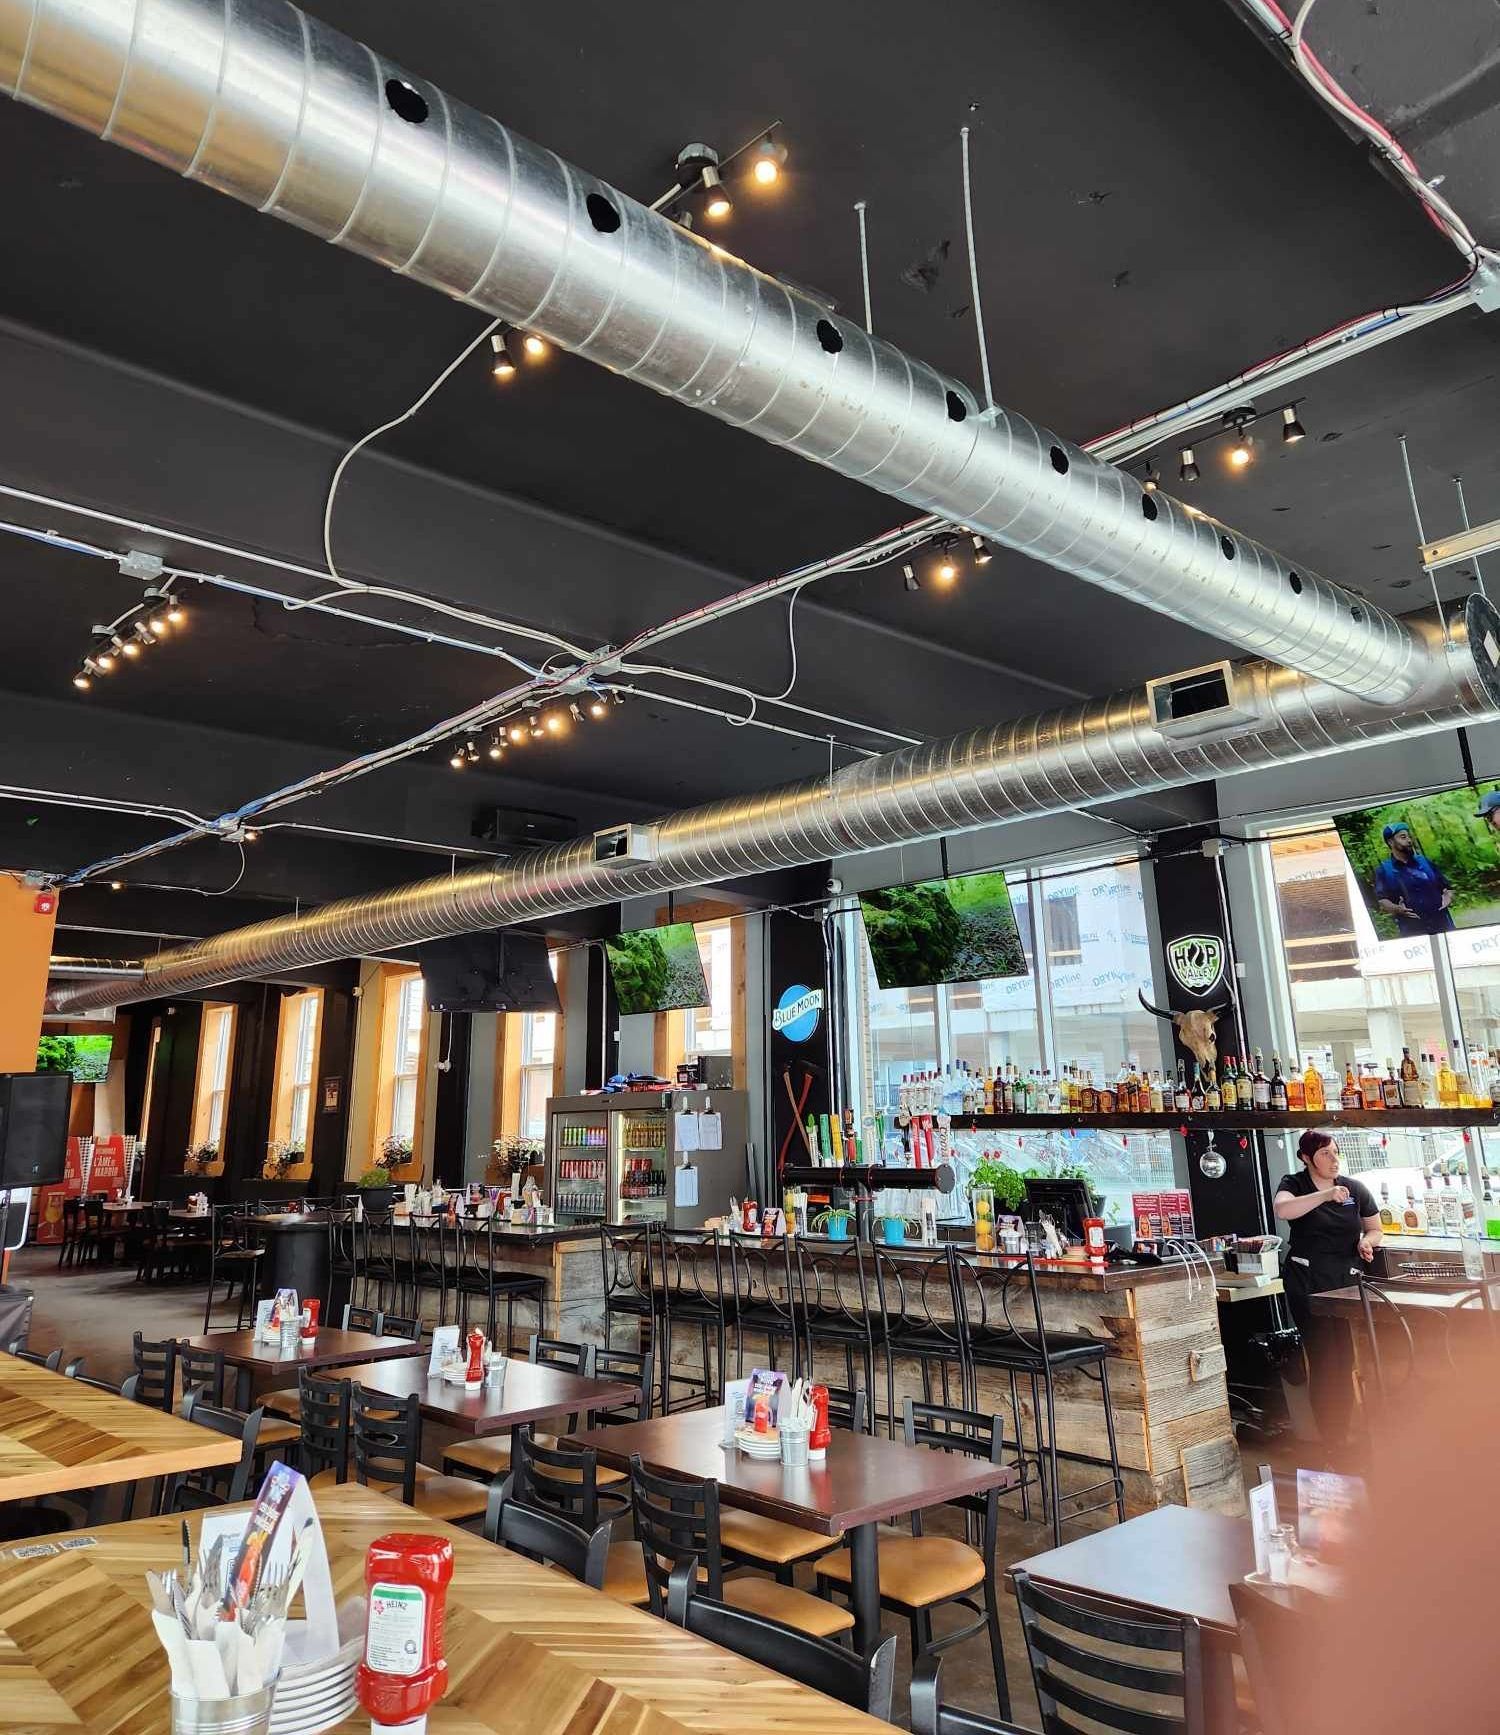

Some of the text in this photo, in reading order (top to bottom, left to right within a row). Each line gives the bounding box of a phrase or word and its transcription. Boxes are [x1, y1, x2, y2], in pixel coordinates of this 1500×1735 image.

[1179, 966, 1213, 979] VALLEY
[773, 992, 820, 1029] BLUE MOON
[385, 1599, 409, 1611] HEINZ
